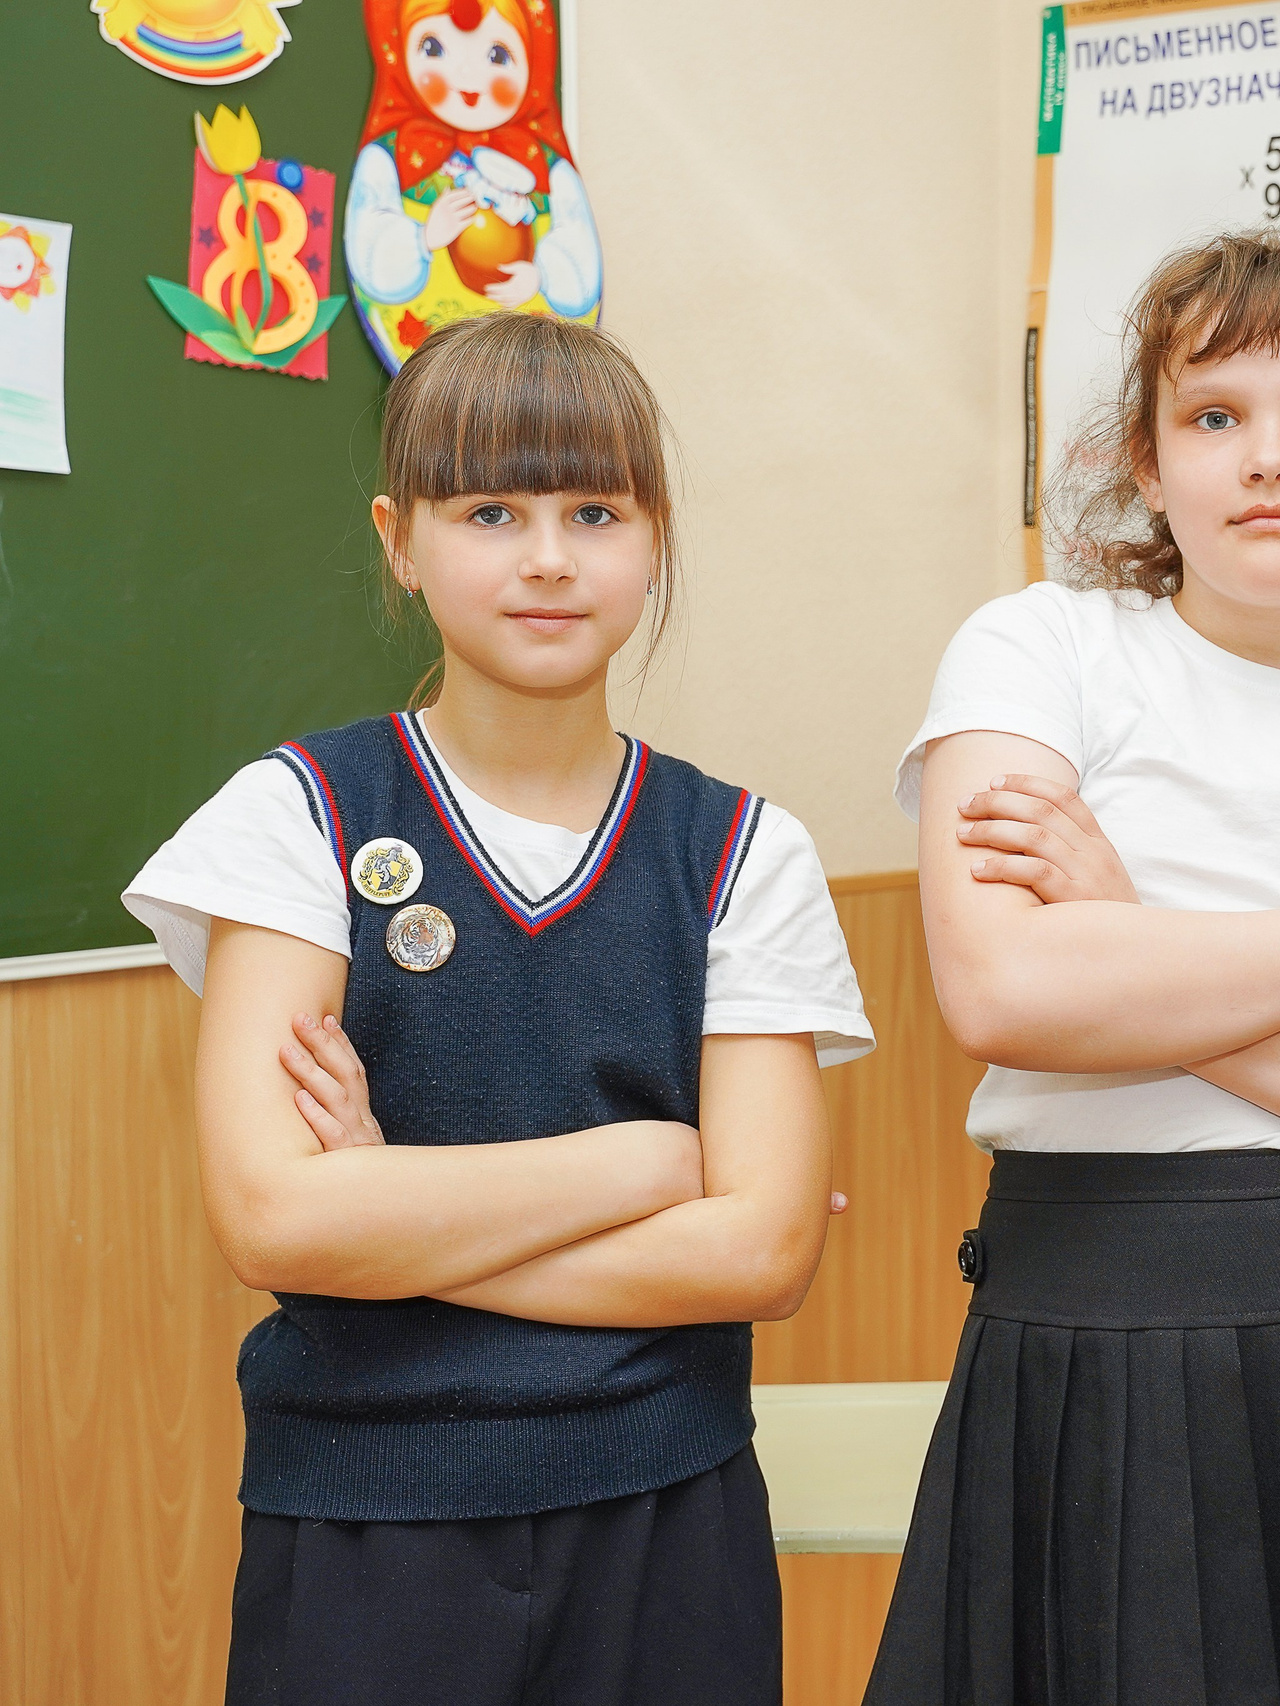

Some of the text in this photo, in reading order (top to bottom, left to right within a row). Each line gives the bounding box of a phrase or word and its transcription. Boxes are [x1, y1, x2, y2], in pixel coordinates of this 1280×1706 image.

[1074, 19, 1278, 69] ПИСЬМЕННОЕ
[1099, 88, 1138, 117] НА
[202, 179, 319, 355] 8
